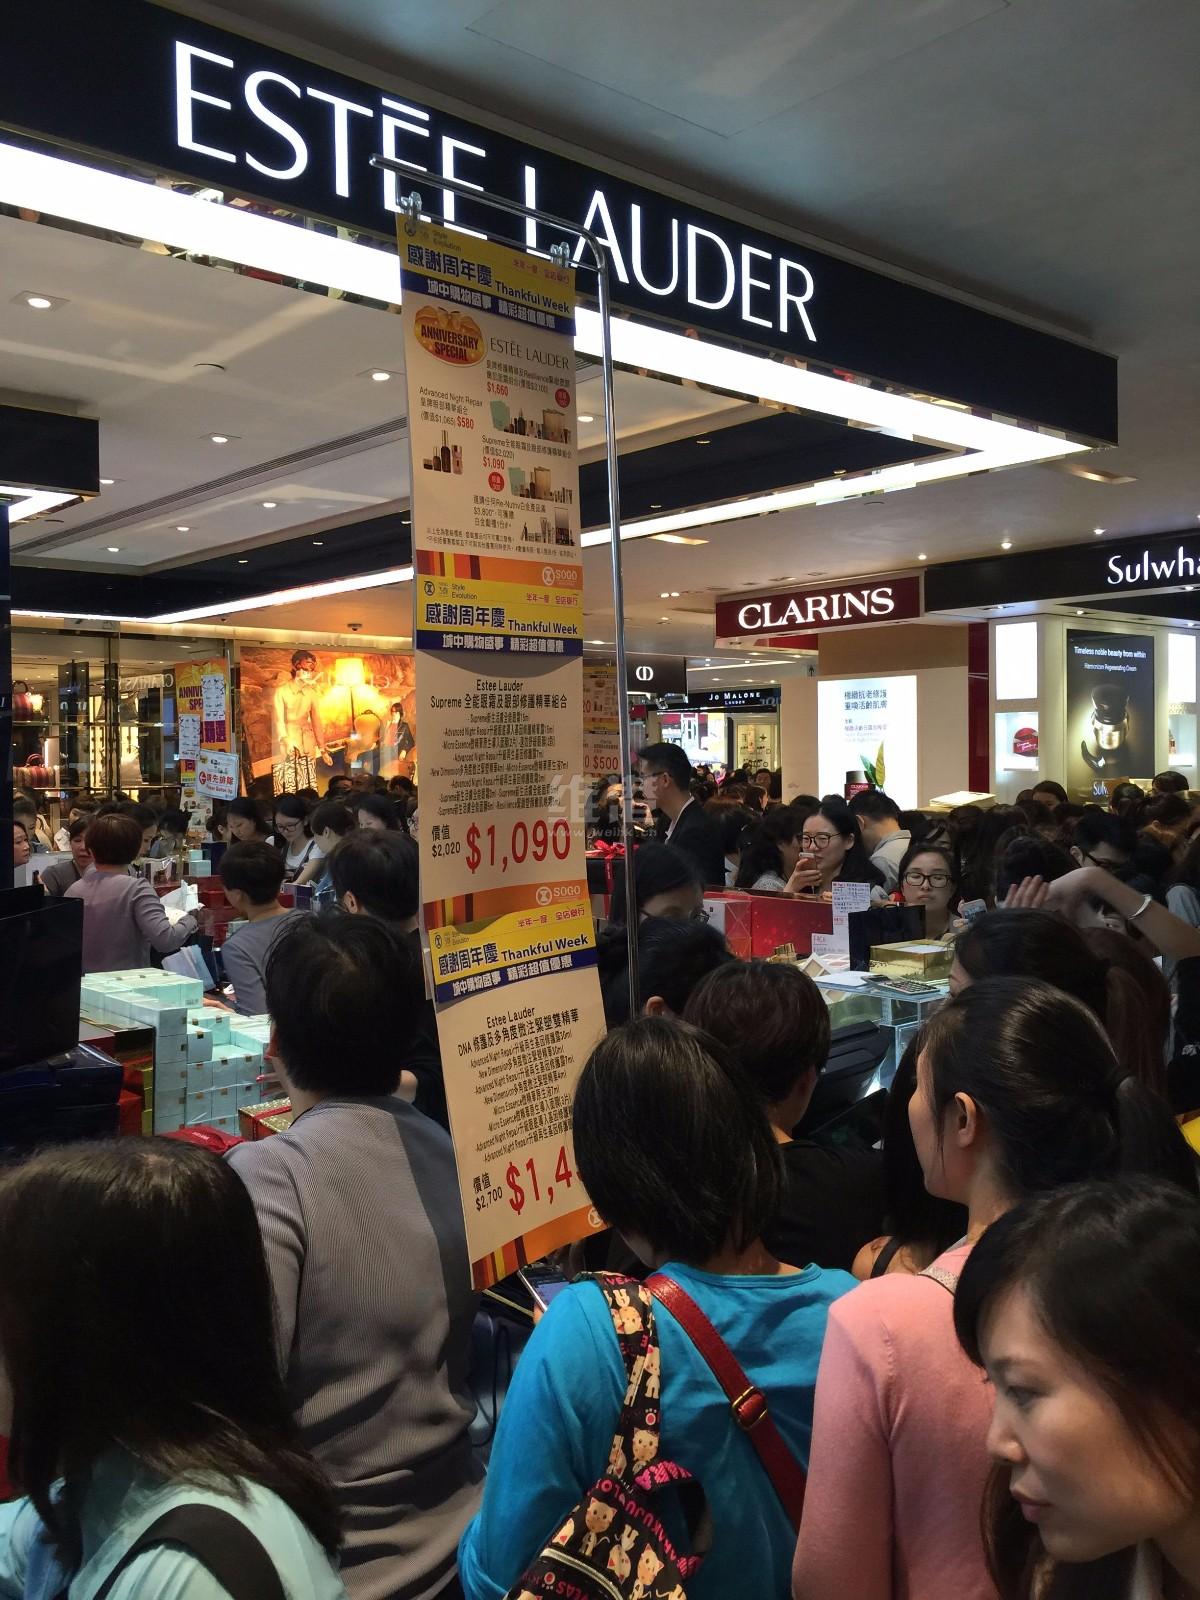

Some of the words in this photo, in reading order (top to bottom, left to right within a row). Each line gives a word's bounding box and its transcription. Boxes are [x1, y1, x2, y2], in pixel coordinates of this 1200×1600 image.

[525, 164, 818, 342] LAUDER
[407, 243, 493, 289] 感謝周年慶
[495, 280, 540, 305] Thankful
[542, 295, 570, 314] Week
[420, 326, 479, 351] ANNIVERSARY
[434, 342, 469, 362] SPECIAL
[526, 347, 570, 370] LAUDER
[419, 386, 449, 400] Advanced
[449, 391, 465, 404] Night
[457, 416, 475, 430] $580
[482, 456, 505, 470] $1,090
[554, 569, 578, 581] SOGO
[451, 591, 478, 600] Evolution
[738, 587, 895, 630] CLARINS
[425, 602, 505, 629] 感謝周年慶
[508, 619, 551, 634] Thankful
[552, 622, 578, 635] Week
[1107, 648, 1122, 658] beauty
[1123, 650, 1134, 658] from
[476, 679, 497, 692] Estee
[498, 680, 524, 692] Lauder
[430, 696, 462, 709] Supreme
[724, 692, 760, 700] MALONE
[593, 755, 619, 770] $500
[431, 824, 451, 842] 價值
[431, 841, 461, 858] $2,020
[465, 818, 571, 874] $1,090
[553, 885, 580, 897] SOGO
[438, 942, 499, 977] 感謝周年慶
[501, 939, 554, 963] Thankful
[555, 934, 589, 950] Week
[486, 1013, 507, 1029] Estee
[507, 1006, 536, 1023] Lauder
[457, 1043, 473, 1057] DNA
[473, 1172, 491, 1194] 價值
[475, 1187, 503, 1213] $2,700
